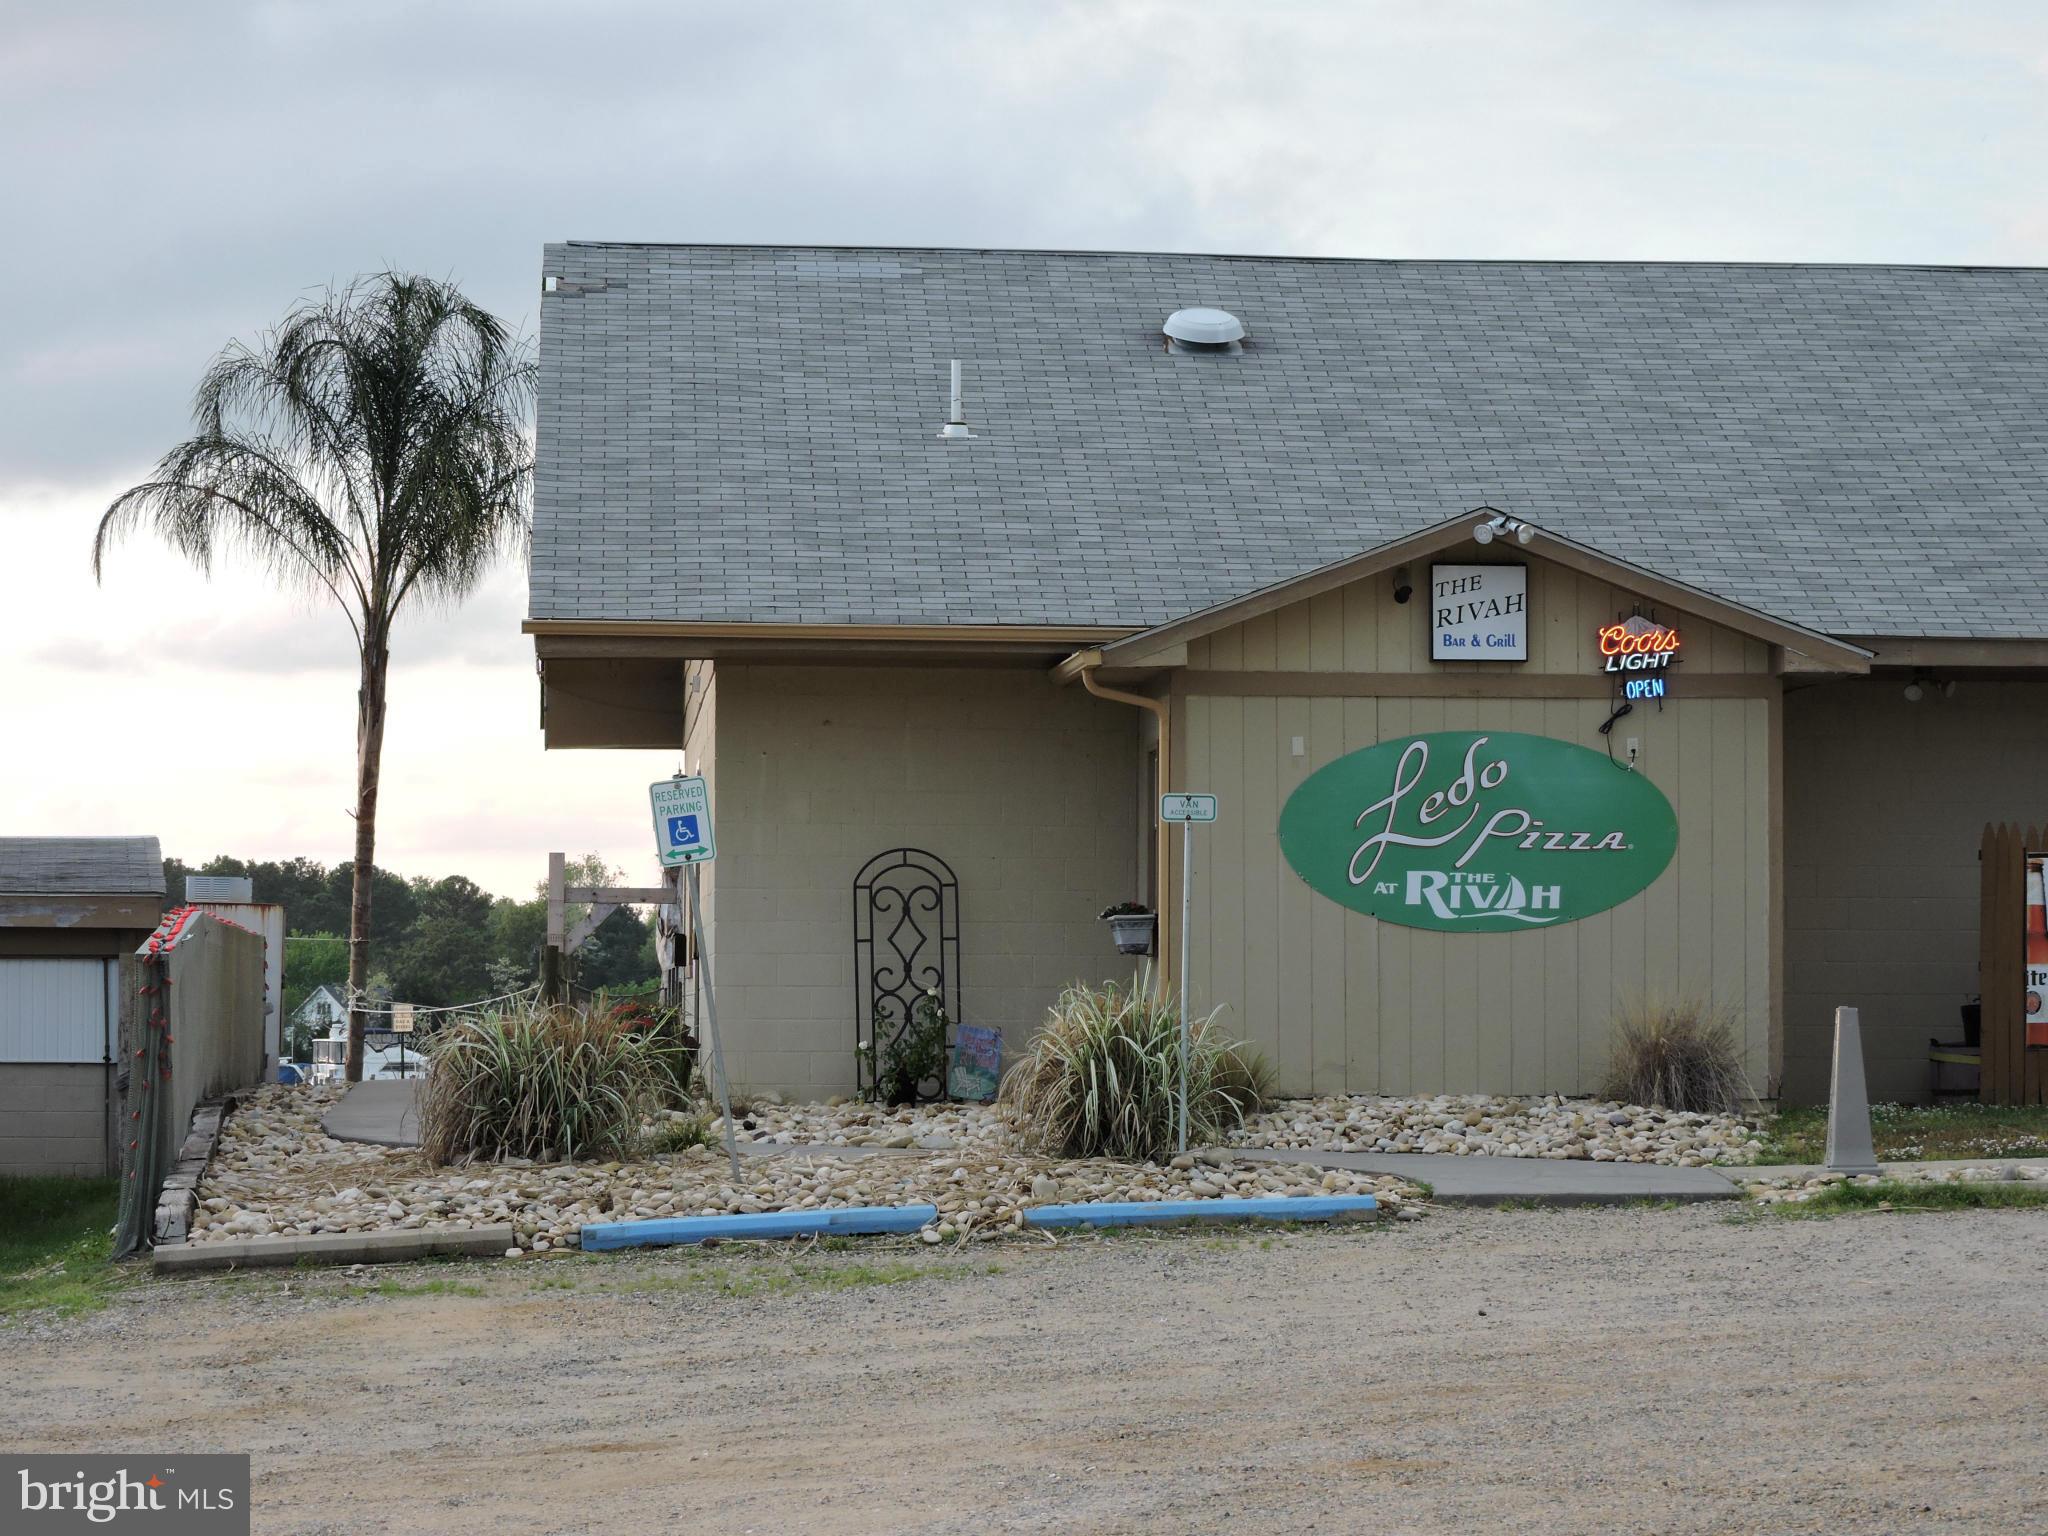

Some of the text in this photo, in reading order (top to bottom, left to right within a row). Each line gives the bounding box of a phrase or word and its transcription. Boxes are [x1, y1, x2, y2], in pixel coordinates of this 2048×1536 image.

[1436, 575, 1482, 598] THE
[1436, 593, 1525, 628] RIVAH
[1471, 634, 1481, 647] &
[1600, 625, 1680, 656] Coors
[1605, 651, 1674, 672] LIGHT
[1626, 679, 1664, 699] OPEN
[655, 787, 702, 802] RESERVED
[659, 801, 703, 816] PARKING
[1348, 737, 1508, 885] Ledo
[1450, 872, 1495, 883] THE
[1373, 882, 1398, 895] AT
[2025, 970, 2047, 986] ite
